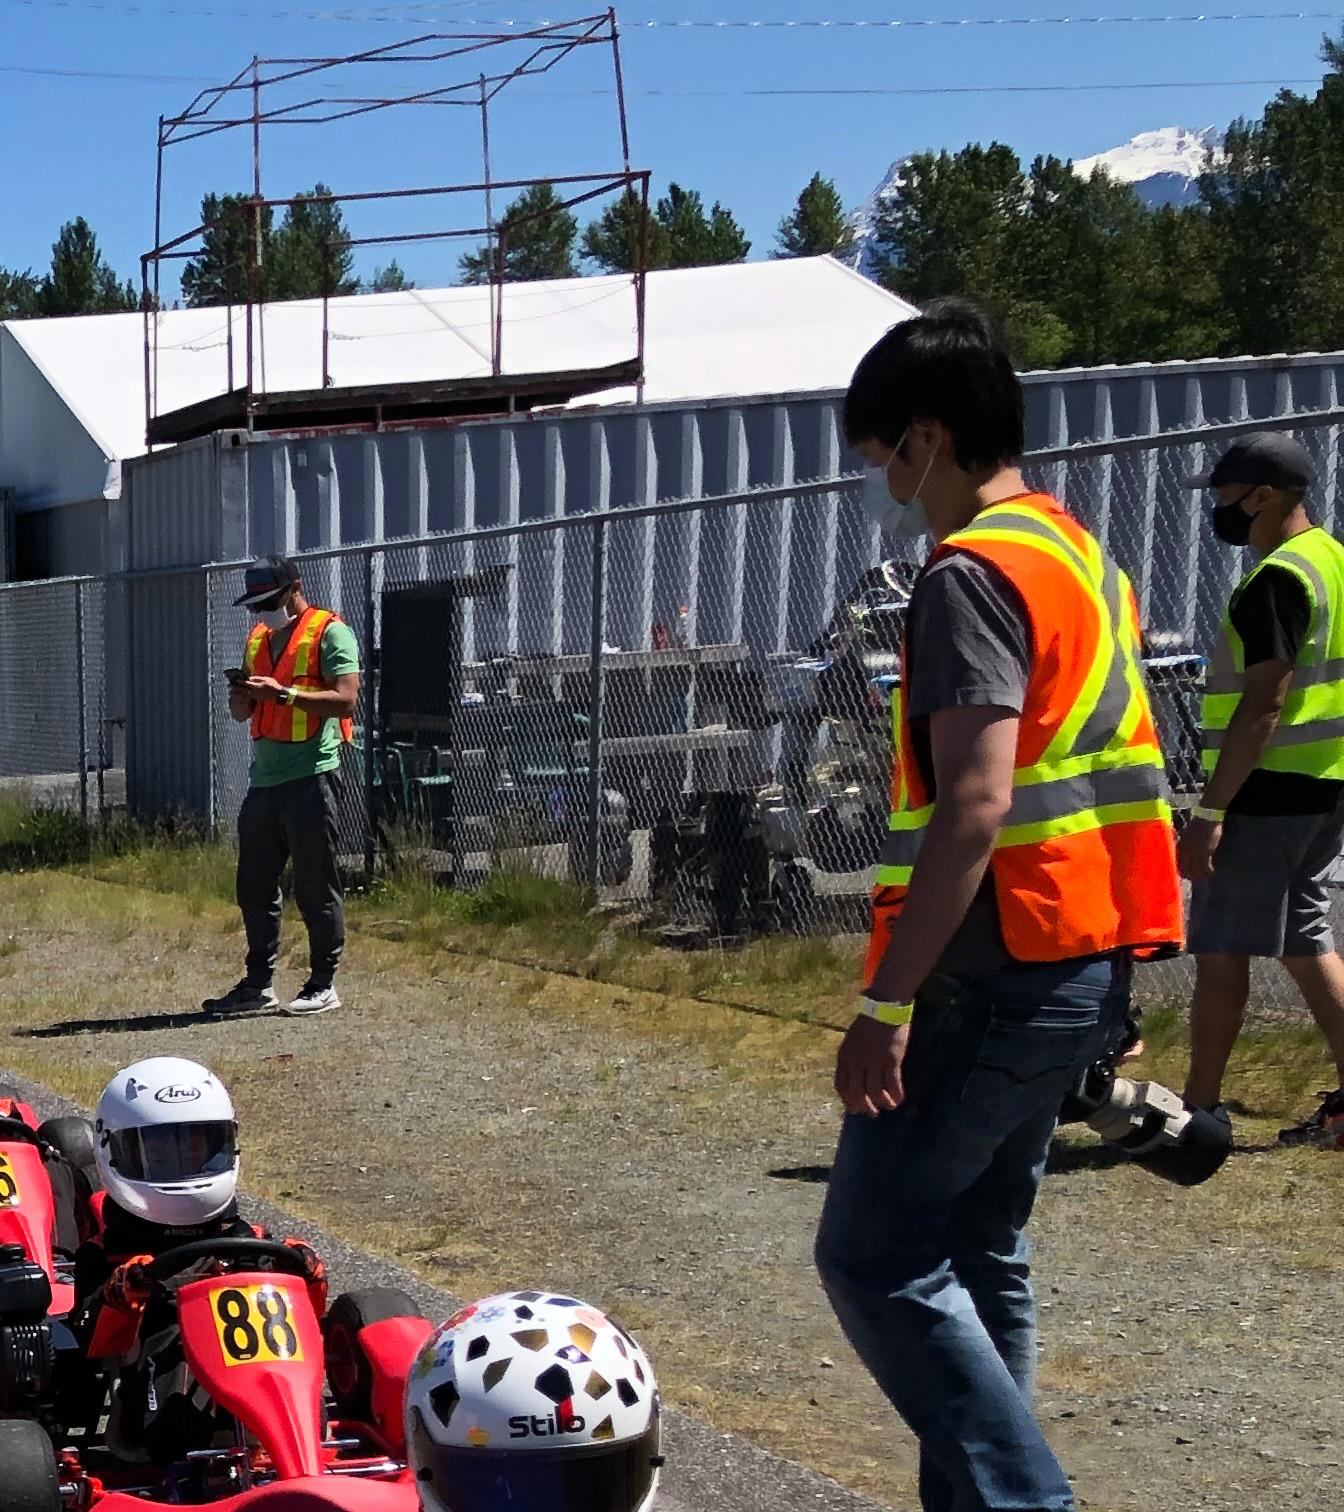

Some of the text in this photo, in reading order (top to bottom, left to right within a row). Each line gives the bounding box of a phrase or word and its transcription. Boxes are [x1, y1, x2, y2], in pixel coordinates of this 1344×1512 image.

[159, 1084, 199, 1102] Arai
[216, 1288, 298, 1361] 88
[508, 1398, 586, 1438] Stilo
